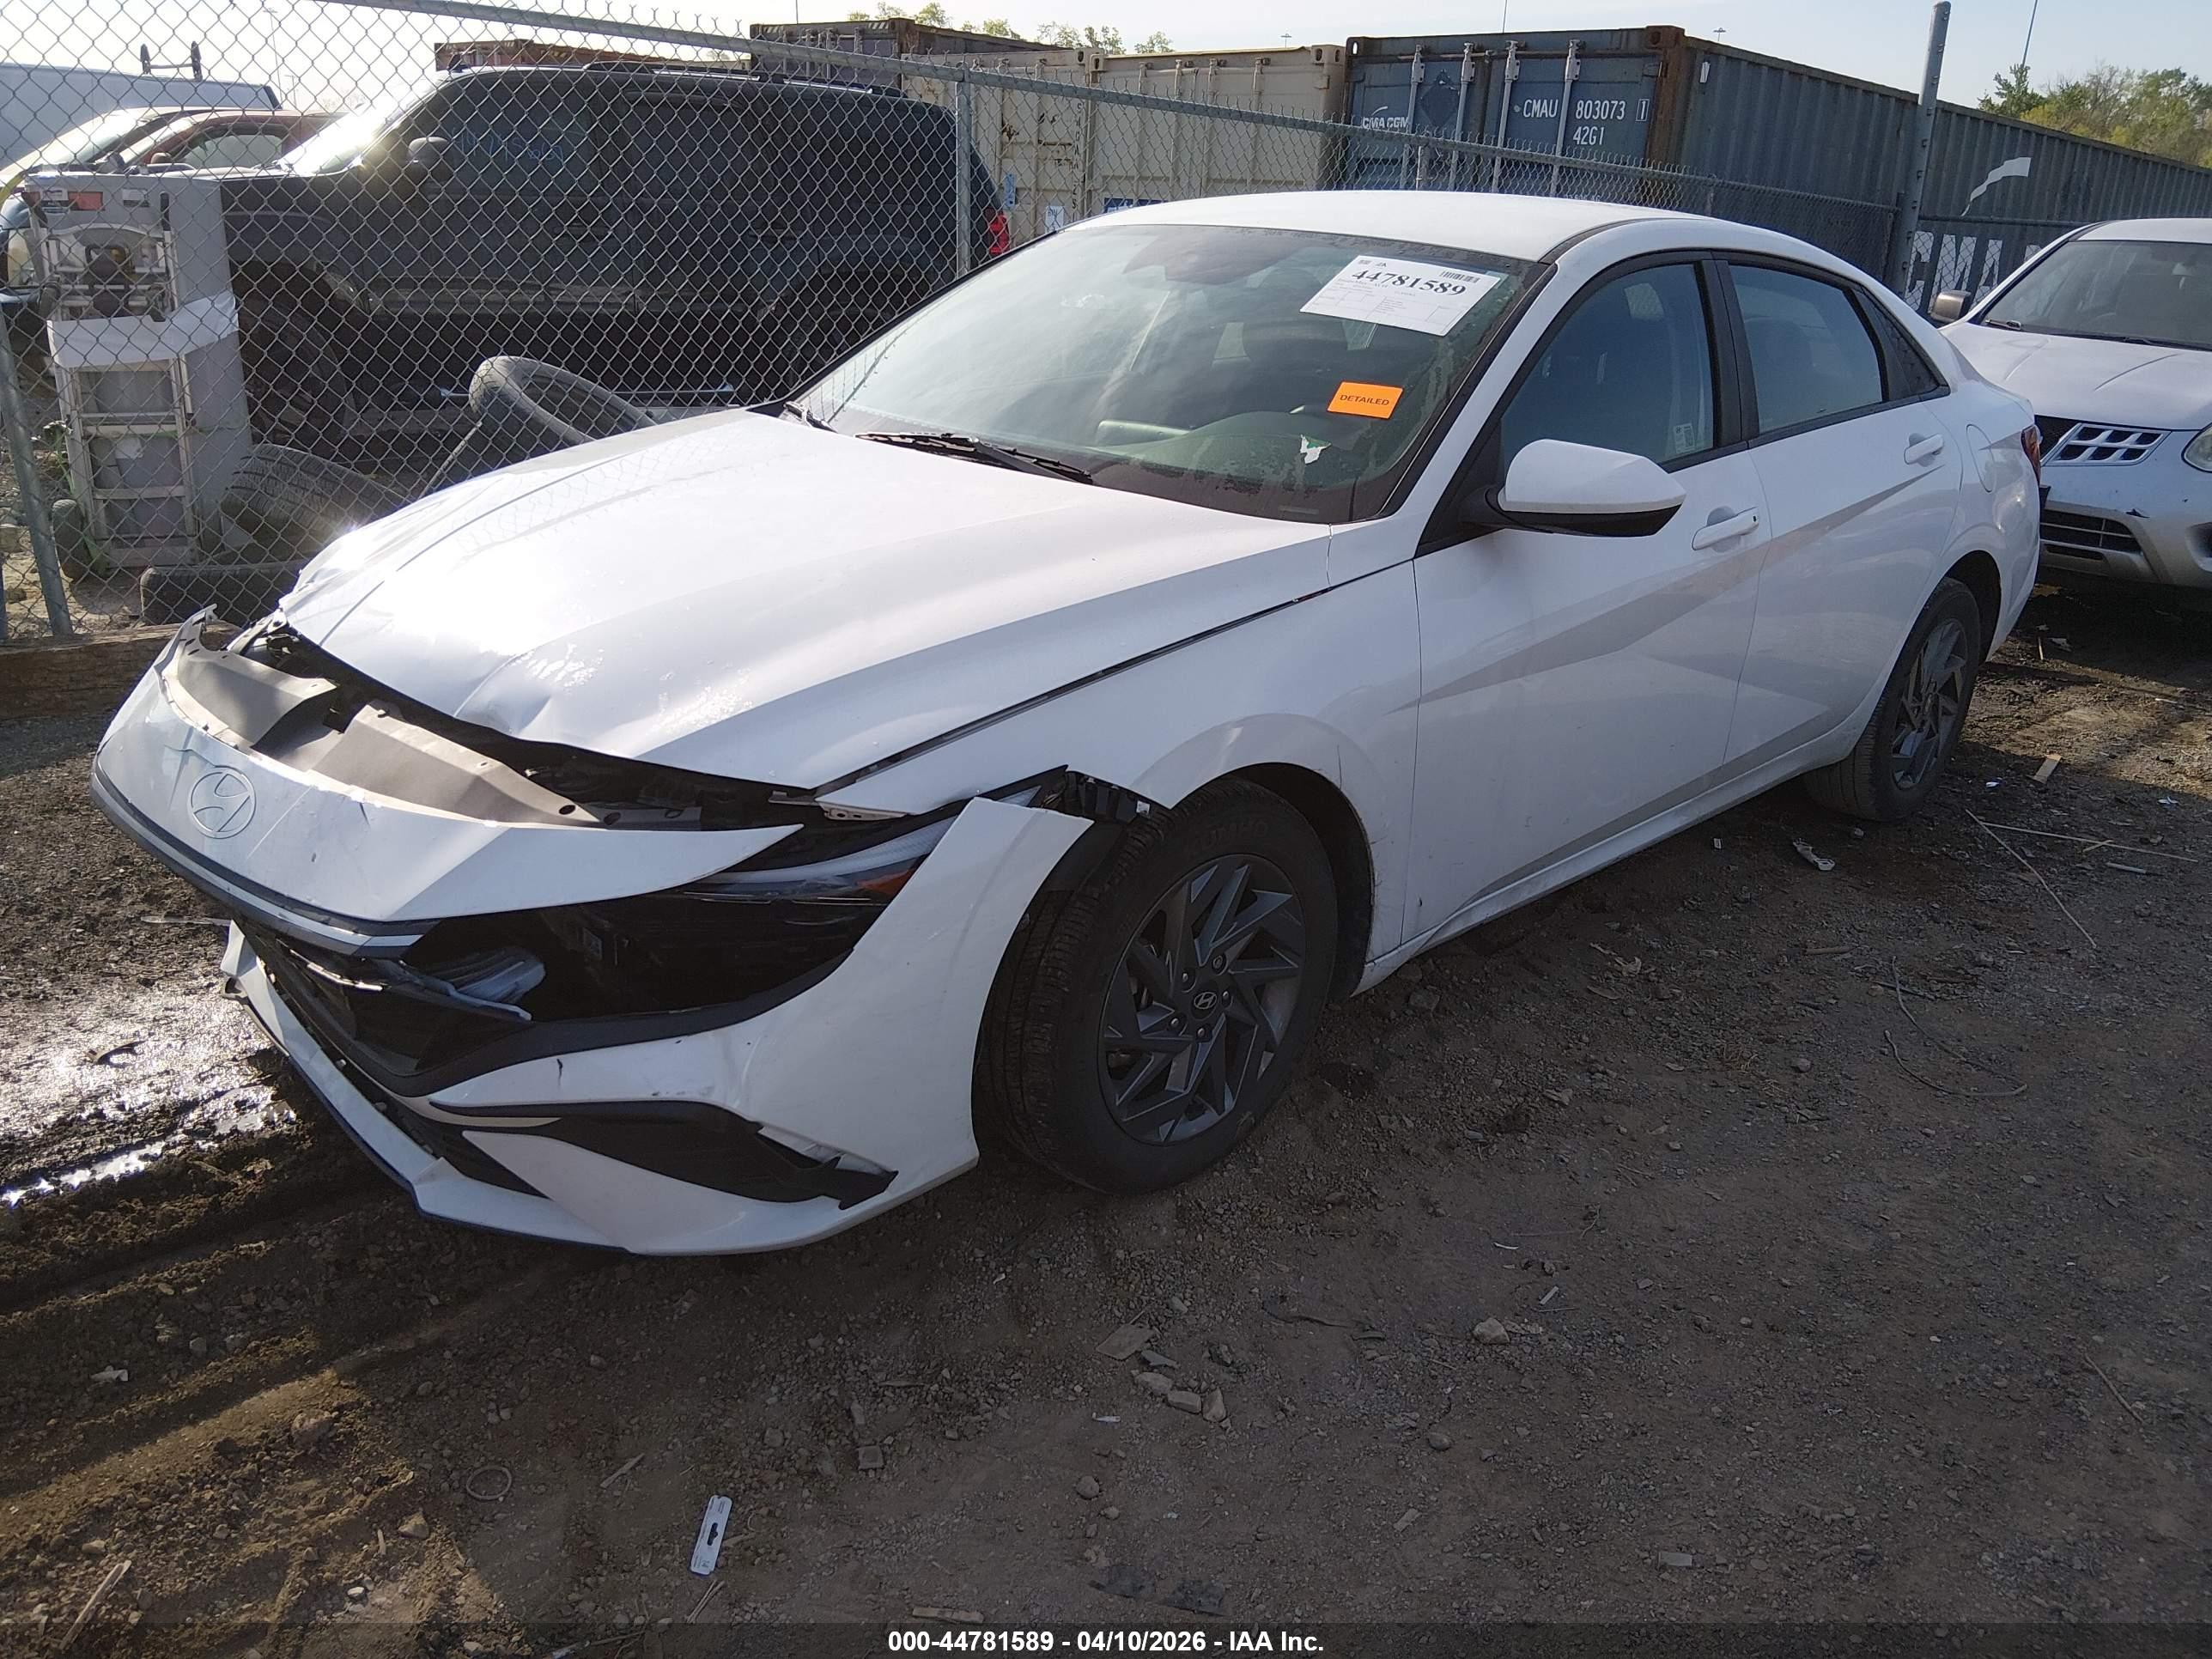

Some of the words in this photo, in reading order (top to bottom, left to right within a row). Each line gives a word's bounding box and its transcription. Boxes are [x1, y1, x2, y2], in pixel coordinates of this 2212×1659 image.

[1523, 99, 1559, 118] CMAU
[1575, 100, 1626, 120] 803073
[1573, 125, 1605, 145] 42G1
[1352, 270, 1467, 295] 44781589
[1905, 231, 2002, 313] CMA
[1340, 393, 1389, 406] DETAILED
